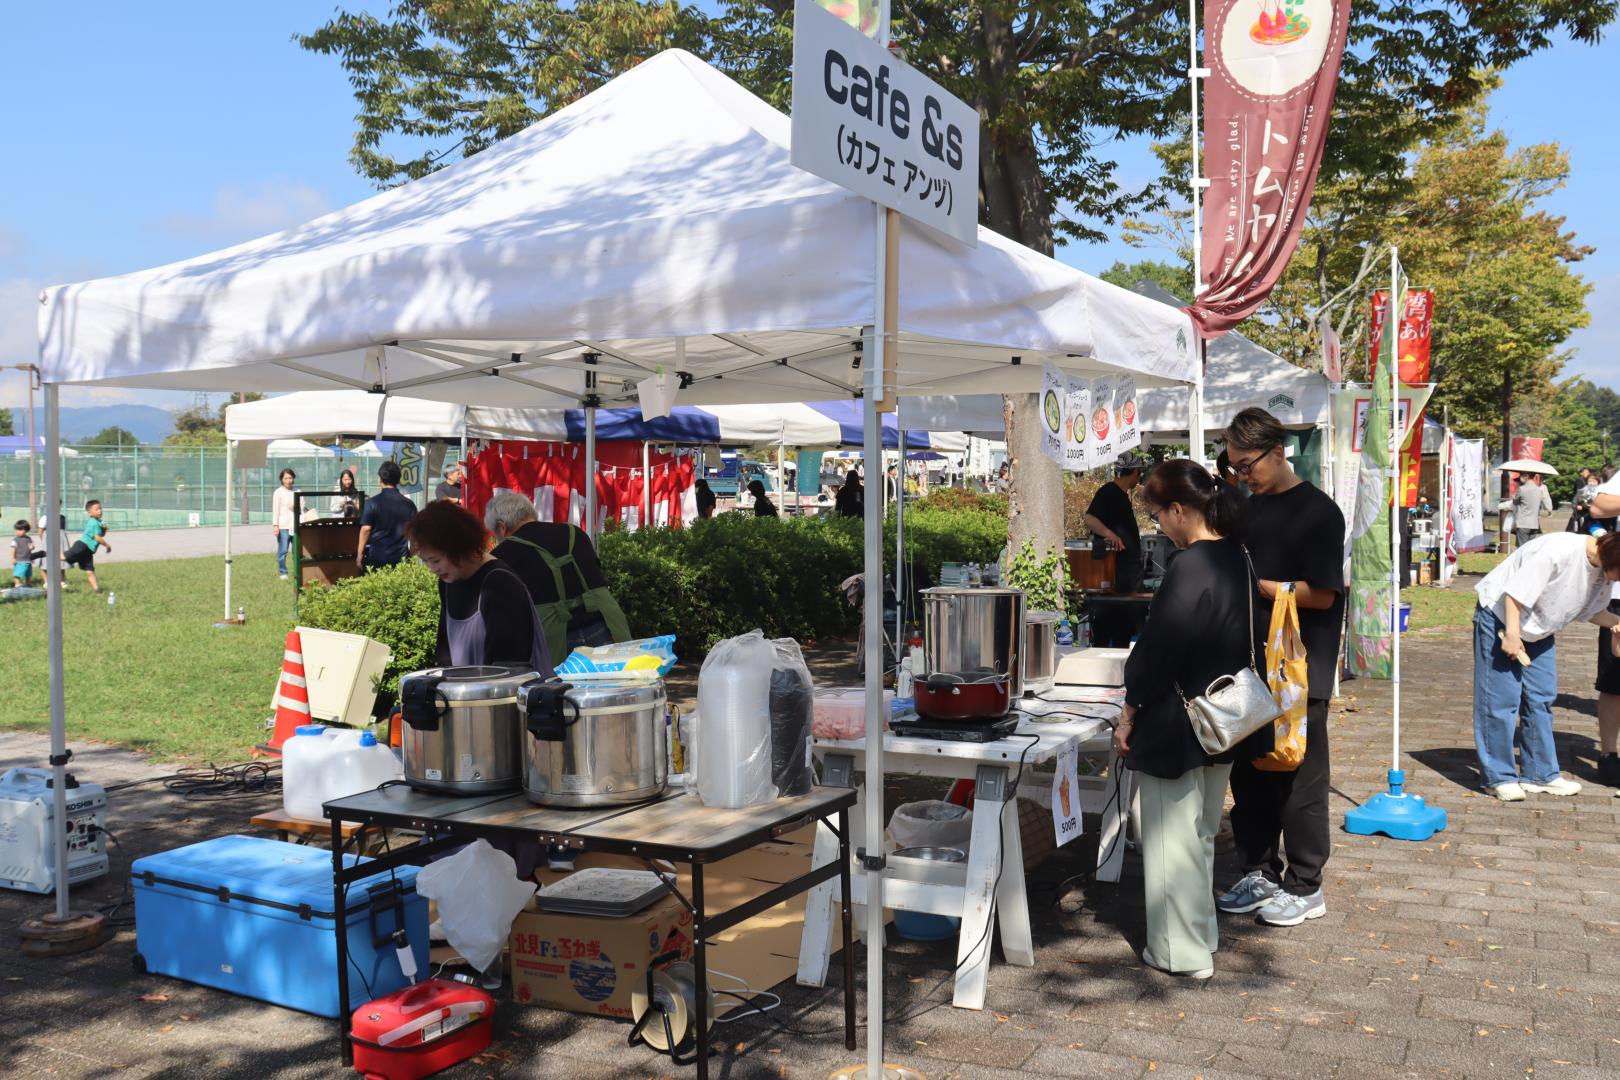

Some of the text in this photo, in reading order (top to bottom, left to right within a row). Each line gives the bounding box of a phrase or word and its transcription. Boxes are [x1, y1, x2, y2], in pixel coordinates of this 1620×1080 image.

[824, 49, 963, 171] cafe &s
[1228, 113, 1241, 151] glad.
[1231, 159, 1241, 187] very
[1229, 196, 1237, 216] are
[1225, 225, 1235, 242] We
[1372, 319, 1433, 344] かあげ
[1096, 443, 1112, 456] 700円
[65, 800, 93, 811] KOSHIN
